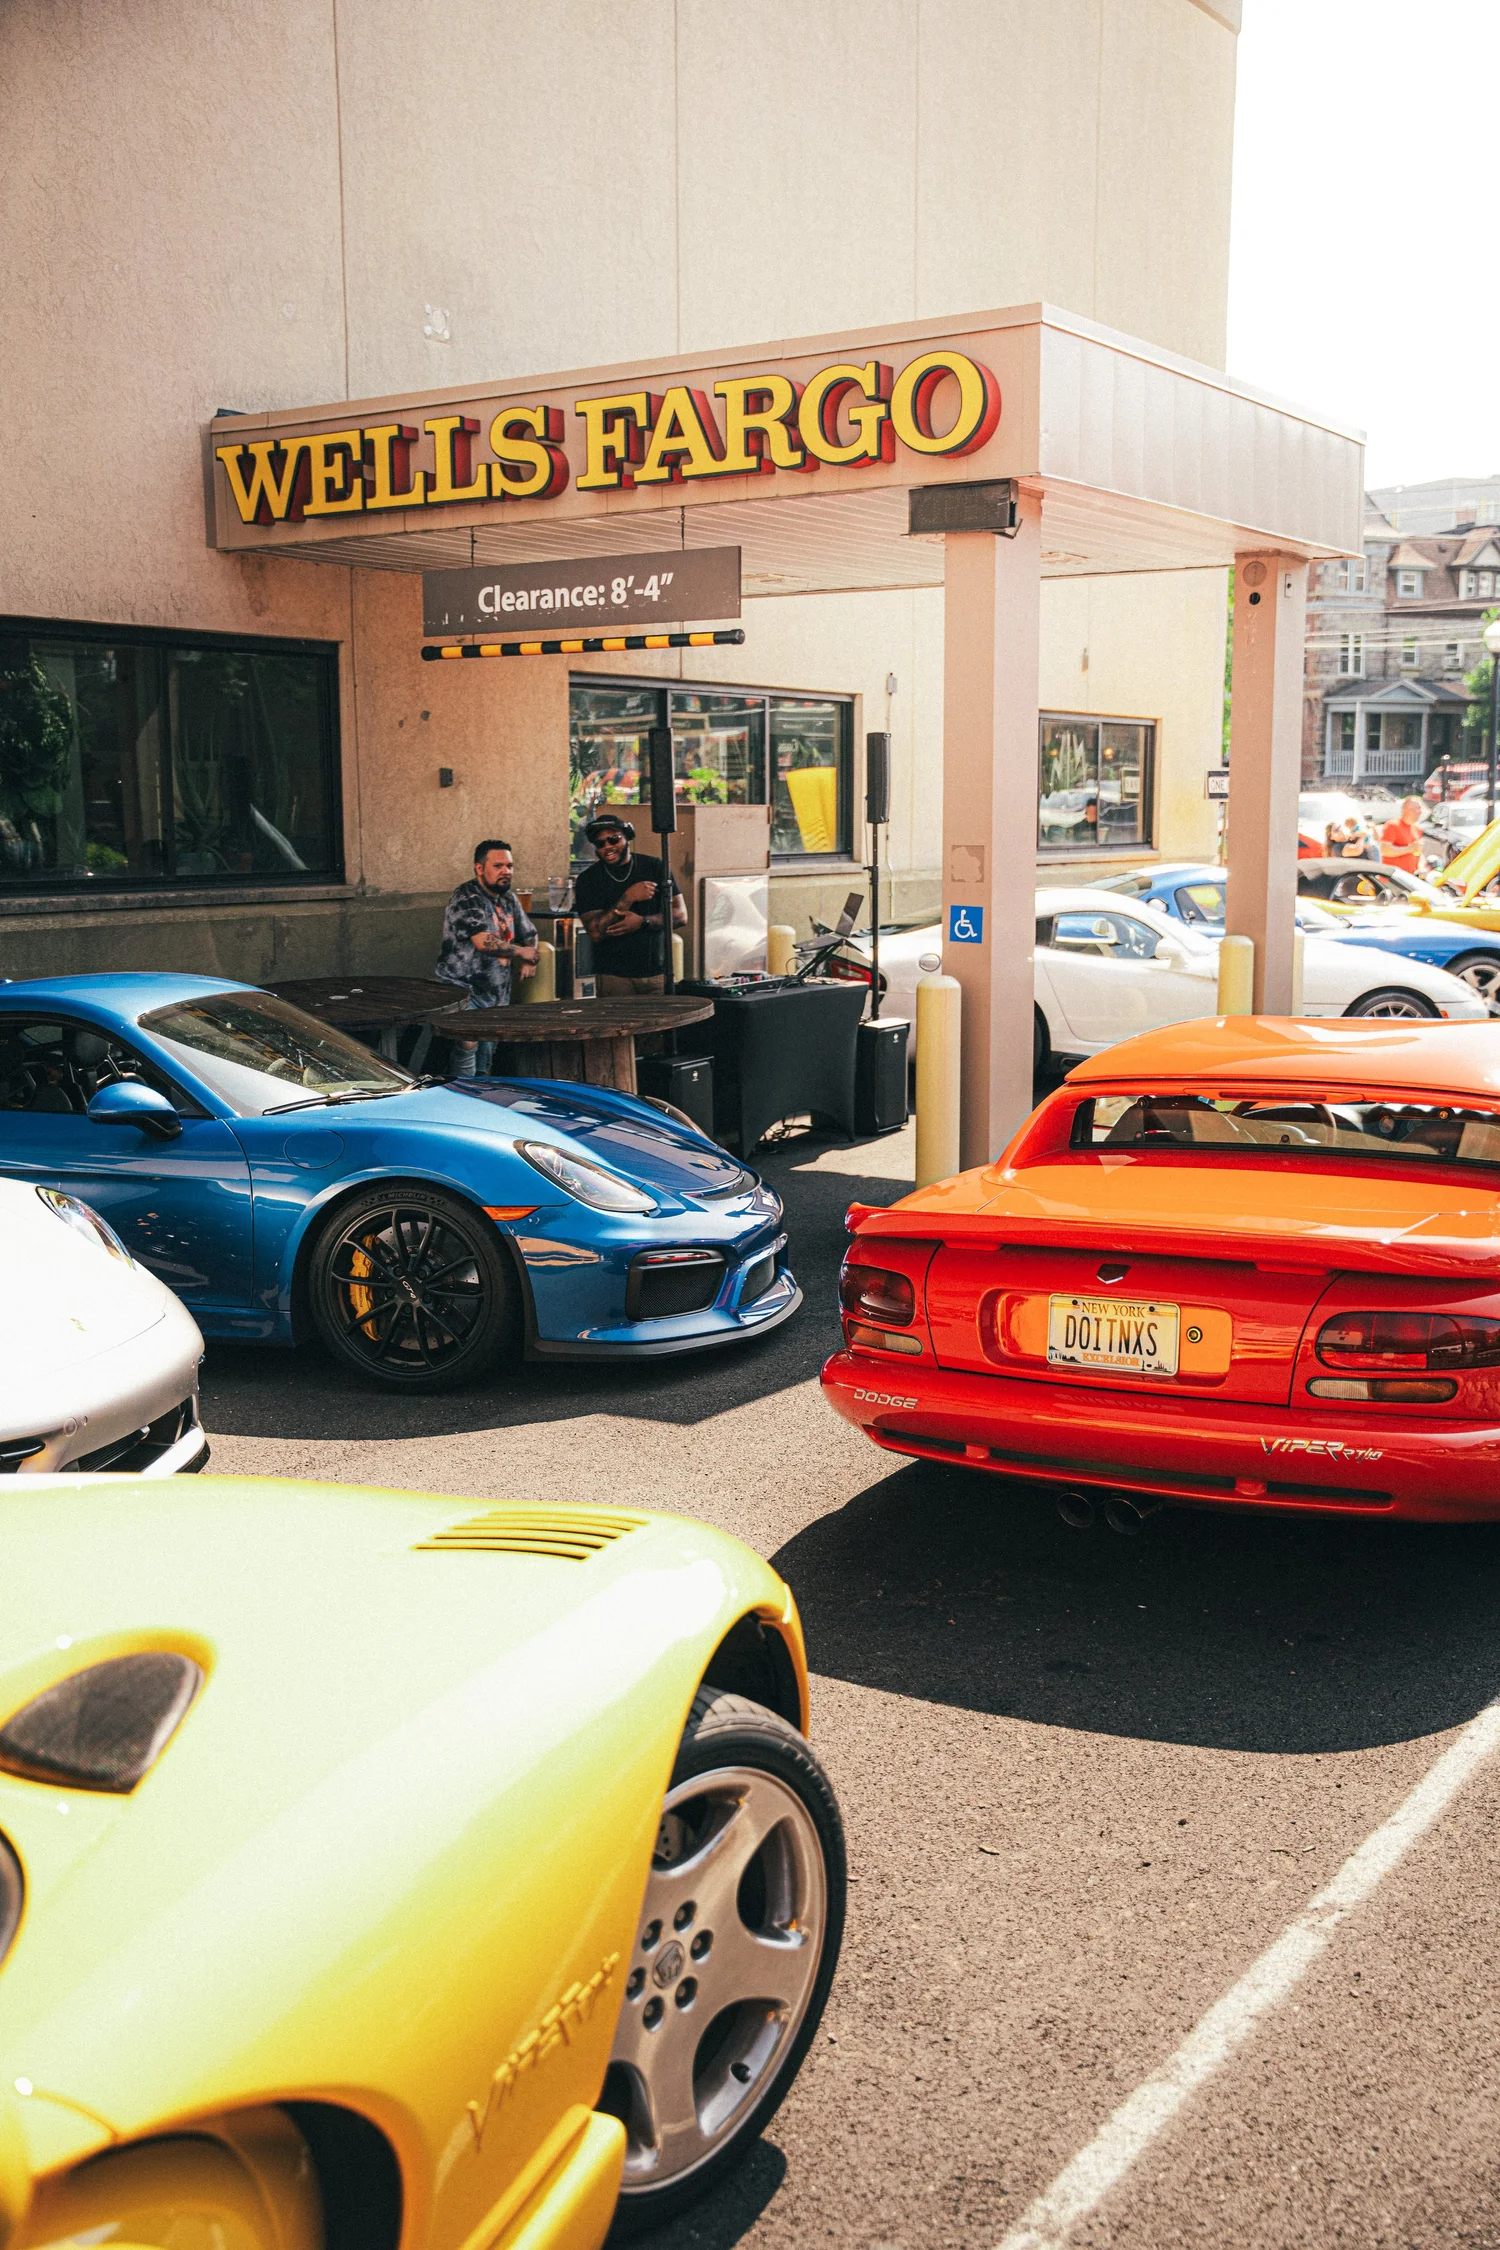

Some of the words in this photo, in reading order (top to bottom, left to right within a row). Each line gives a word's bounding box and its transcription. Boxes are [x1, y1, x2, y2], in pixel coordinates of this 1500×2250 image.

[216, 406, 569, 526] WELLS
[575, 350, 1002, 490] FARGO
[477, 584, 606, 614] Clearance:
[1081, 1302, 1111, 1316] NEW
[1112, 1304, 1146, 1319] YORK
[1064, 1314, 1159, 1357] DOITNXS
[1081, 1352, 1141, 1367] EXCELSIOR
[853, 1388, 919, 1410] DODGE
[1259, 1436, 1345, 1462] VIPER
